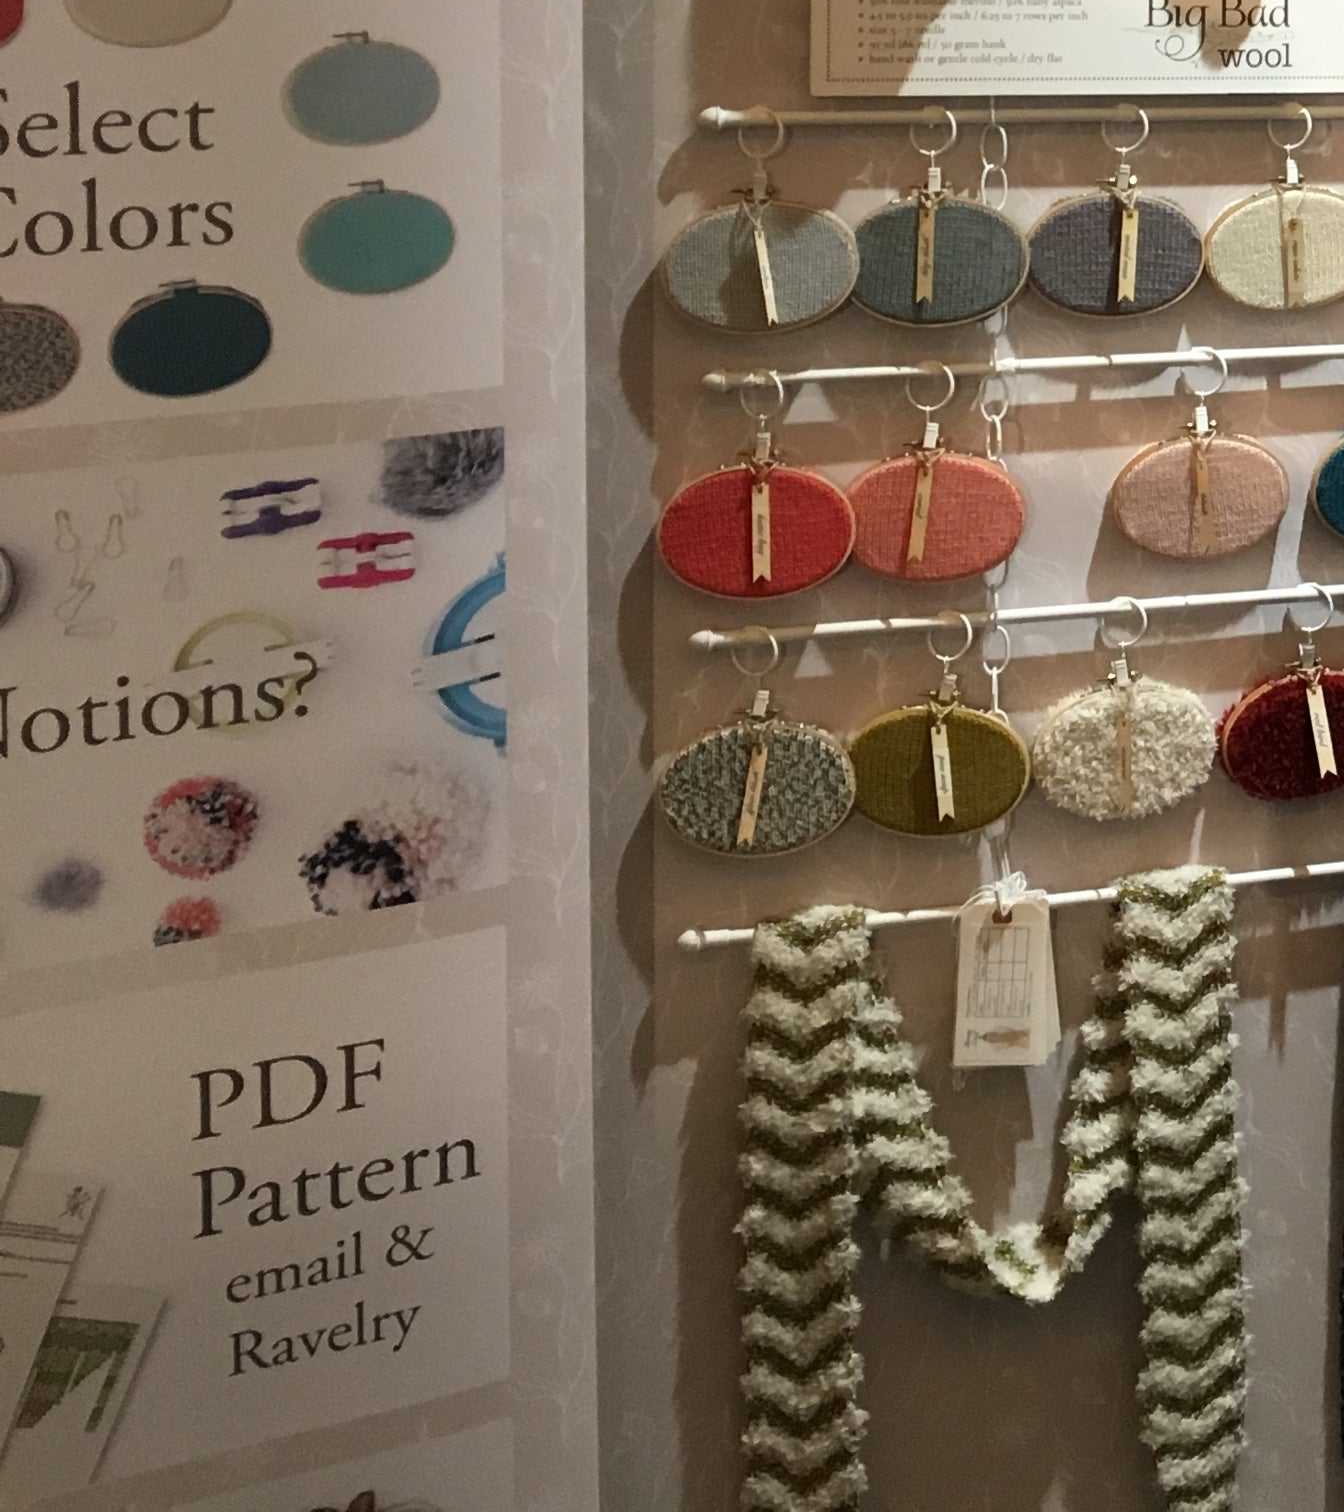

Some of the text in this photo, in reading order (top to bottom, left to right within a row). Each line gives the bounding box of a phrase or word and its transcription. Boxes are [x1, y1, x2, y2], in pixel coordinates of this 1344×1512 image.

[954, 41, 980, 51] gram
[982, 38, 1006, 49] hank
[1049, 13, 1064, 23] per
[1067, 9, 1089, 21] inch
[993, 52, 1018, 66] cycle
[1027, 53, 1043, 66] dry
[1047, 52, 1063, 64] flat
[1217, 43, 1293, 68] wool
[0, 80, 215, 159] elect
[190, 1038, 385, 1141] PDF
[192, 1136, 481, 1239] Pattern
[226, 1224, 435, 1304] email &
[229, 1301, 422, 1376] Ravelry
